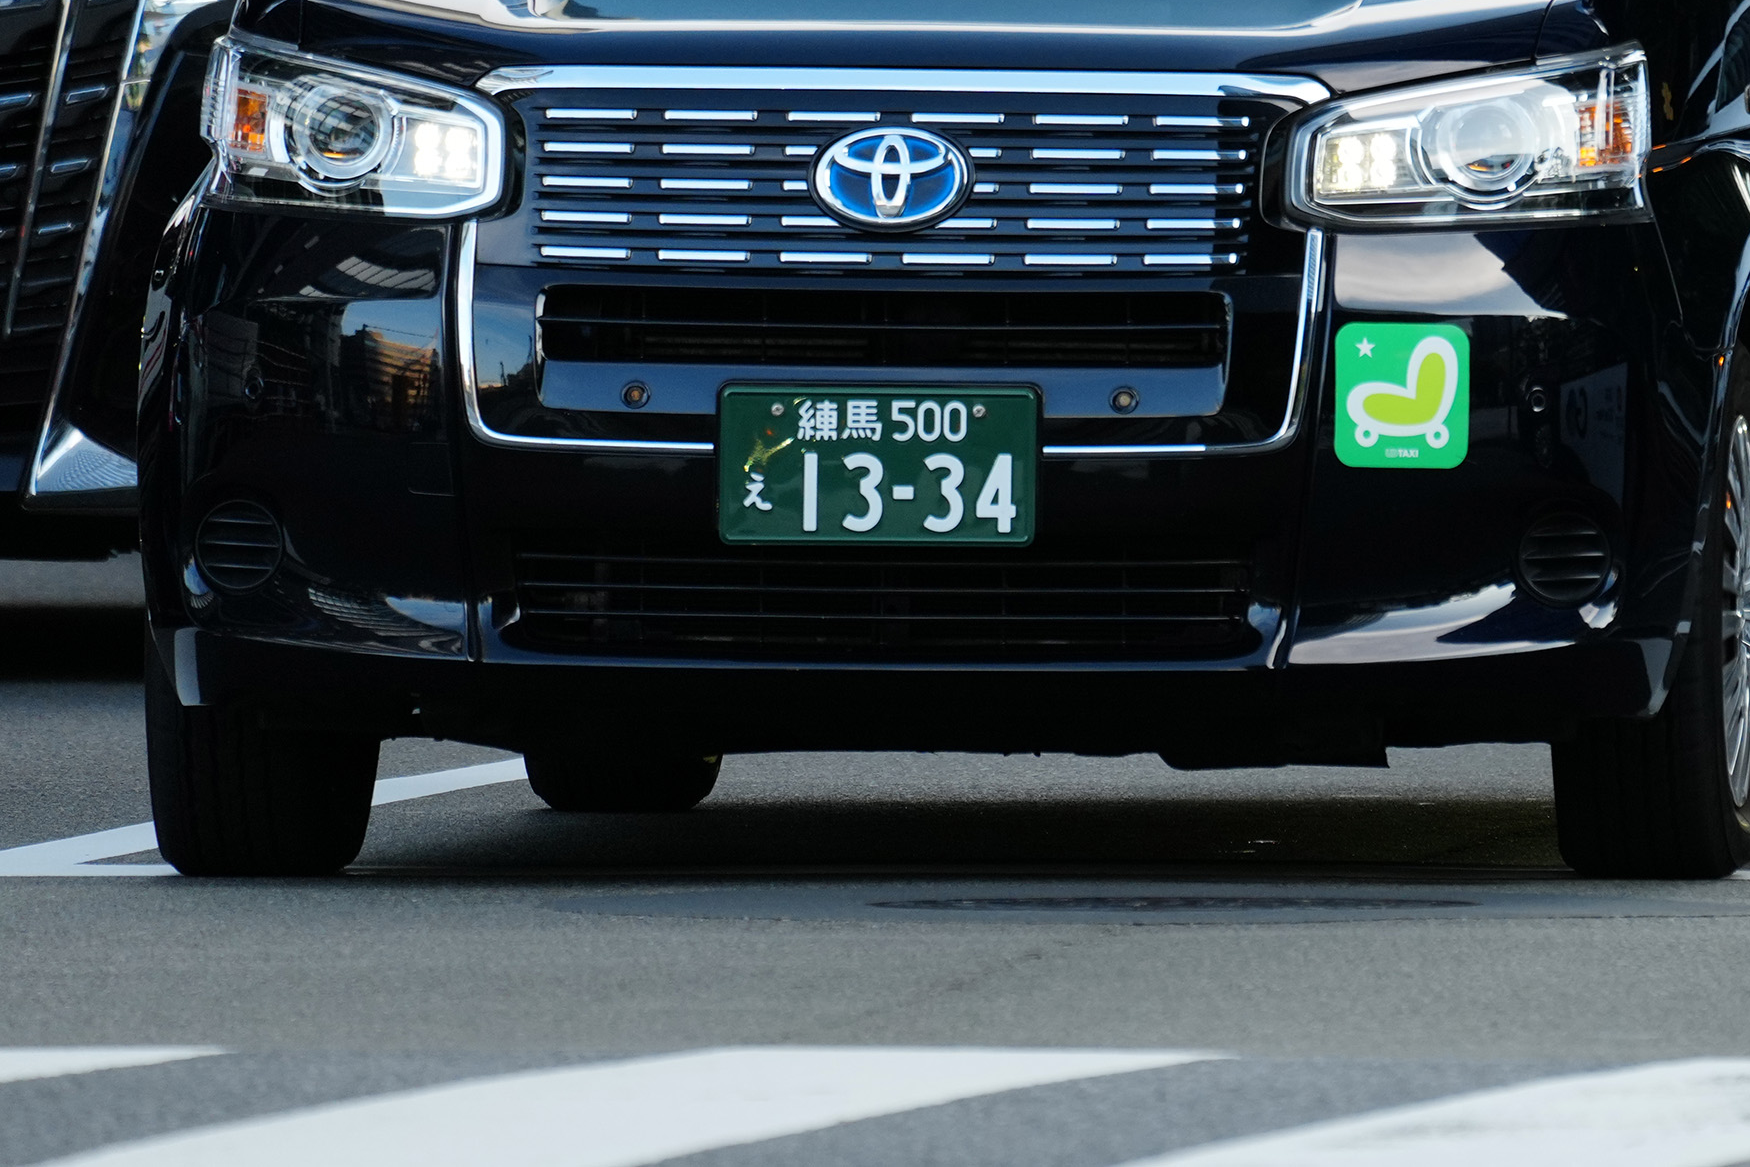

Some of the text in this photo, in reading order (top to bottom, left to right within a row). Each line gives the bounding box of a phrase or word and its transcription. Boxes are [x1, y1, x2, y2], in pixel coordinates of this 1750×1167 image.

[797, 399, 968, 442] 練馬 500
[743, 471, 773, 512] え
[802, 452, 1017, 533] 13-34
